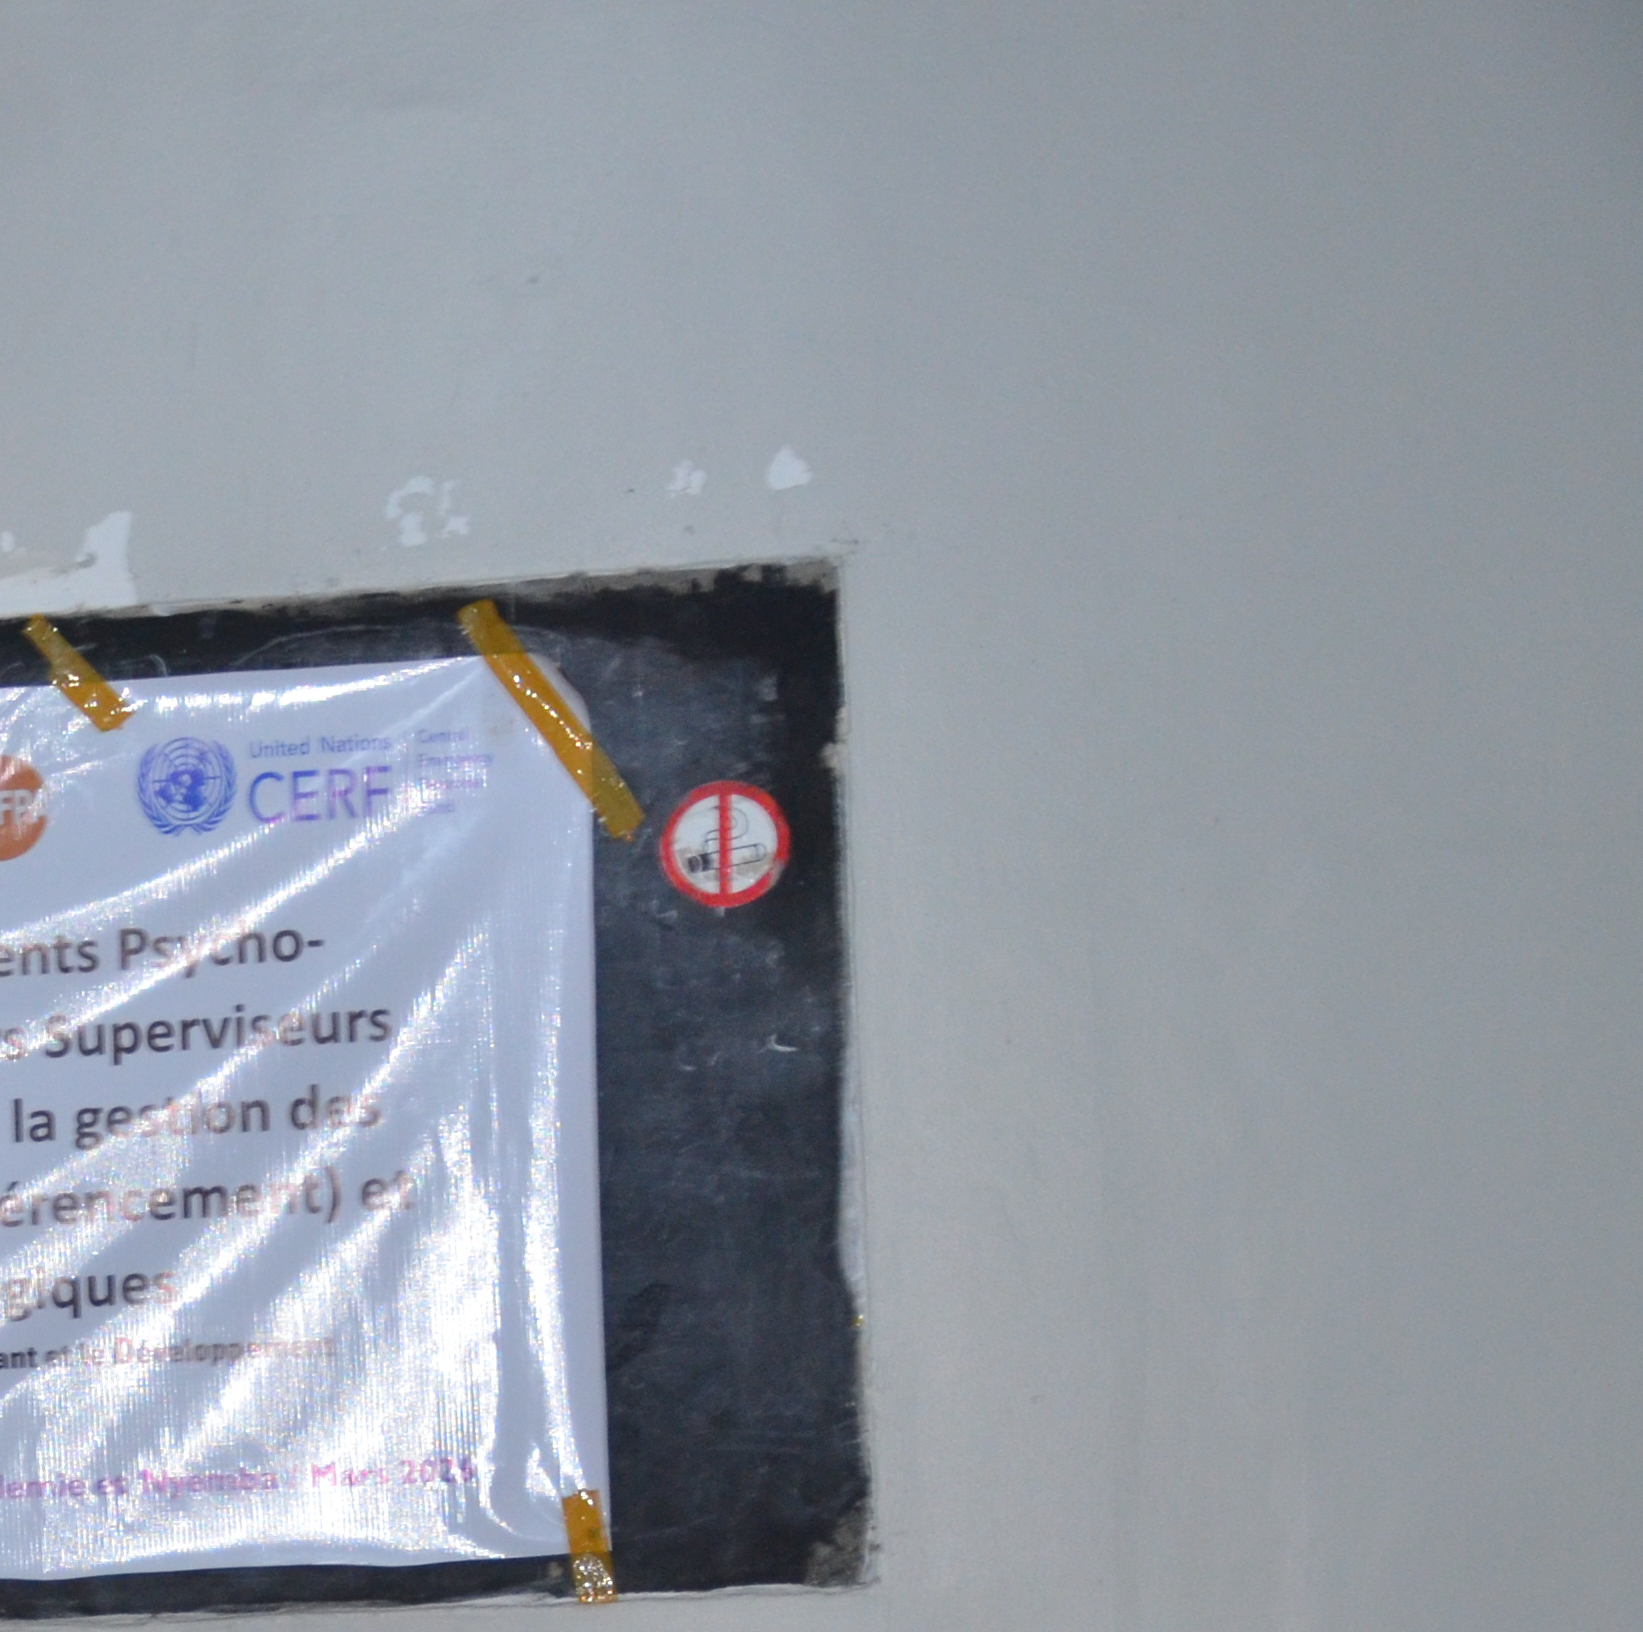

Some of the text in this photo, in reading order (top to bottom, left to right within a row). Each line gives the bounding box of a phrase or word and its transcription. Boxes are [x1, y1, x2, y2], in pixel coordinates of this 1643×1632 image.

[321, 733, 392, 753] Nations
[248, 764, 393, 824] CERF
[45, 1004, 390, 1066] Superviseurs
[13, 1098, 55, 1143] la
[75, 1090, 271, 1152] gestion
[289, 1083, 382, 1132] des
[312, 1461, 392, 1490] Mars
